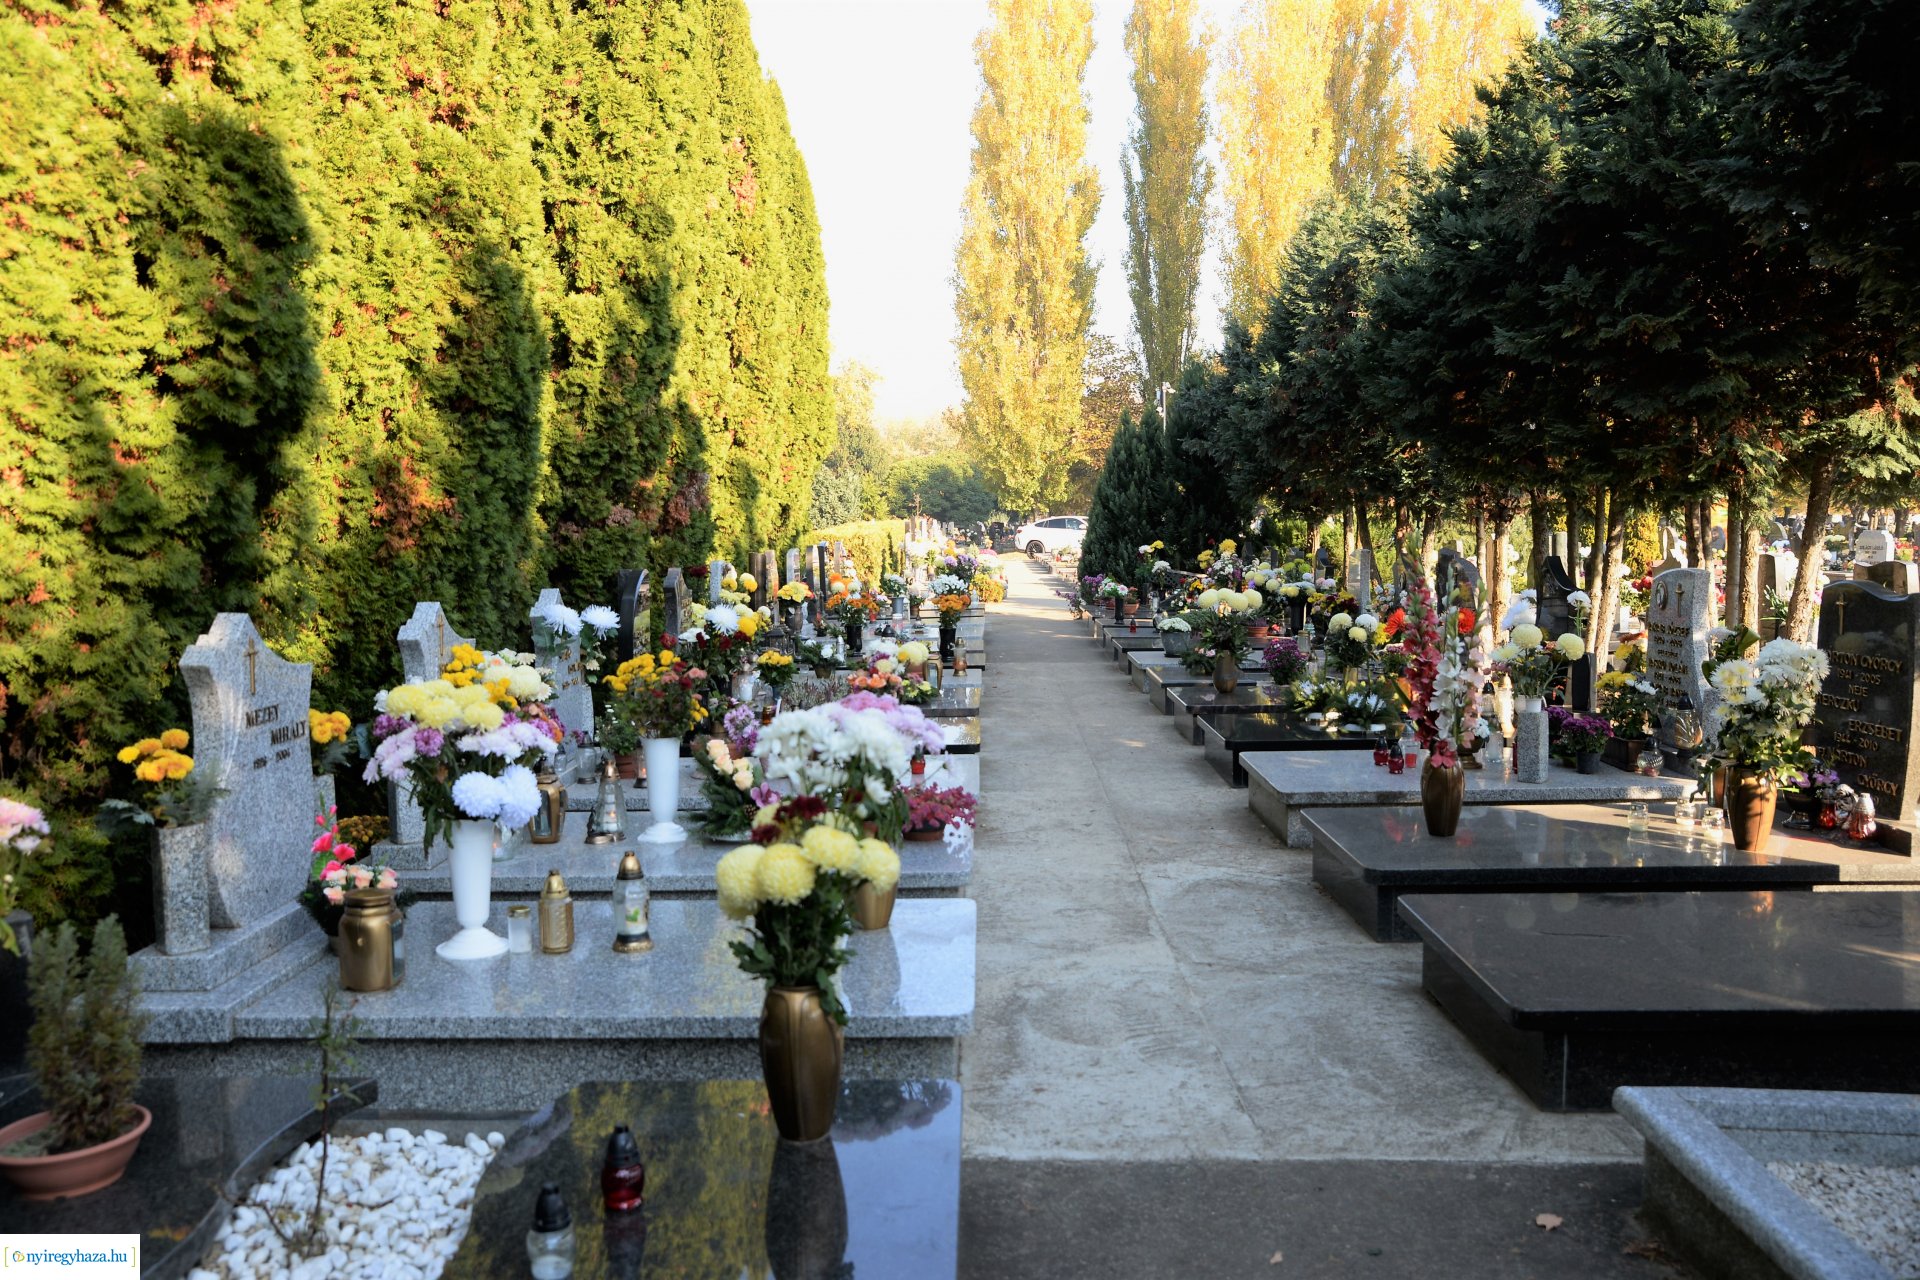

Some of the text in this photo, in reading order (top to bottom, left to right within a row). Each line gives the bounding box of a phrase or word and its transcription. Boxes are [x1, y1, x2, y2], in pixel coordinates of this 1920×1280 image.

[1860, 672, 1881, 685] 2005
[245, 703, 279, 729] MEZEY
[1848, 718, 1903, 742] ERZSÉBET
[1859, 737, 1879, 751] 2010
